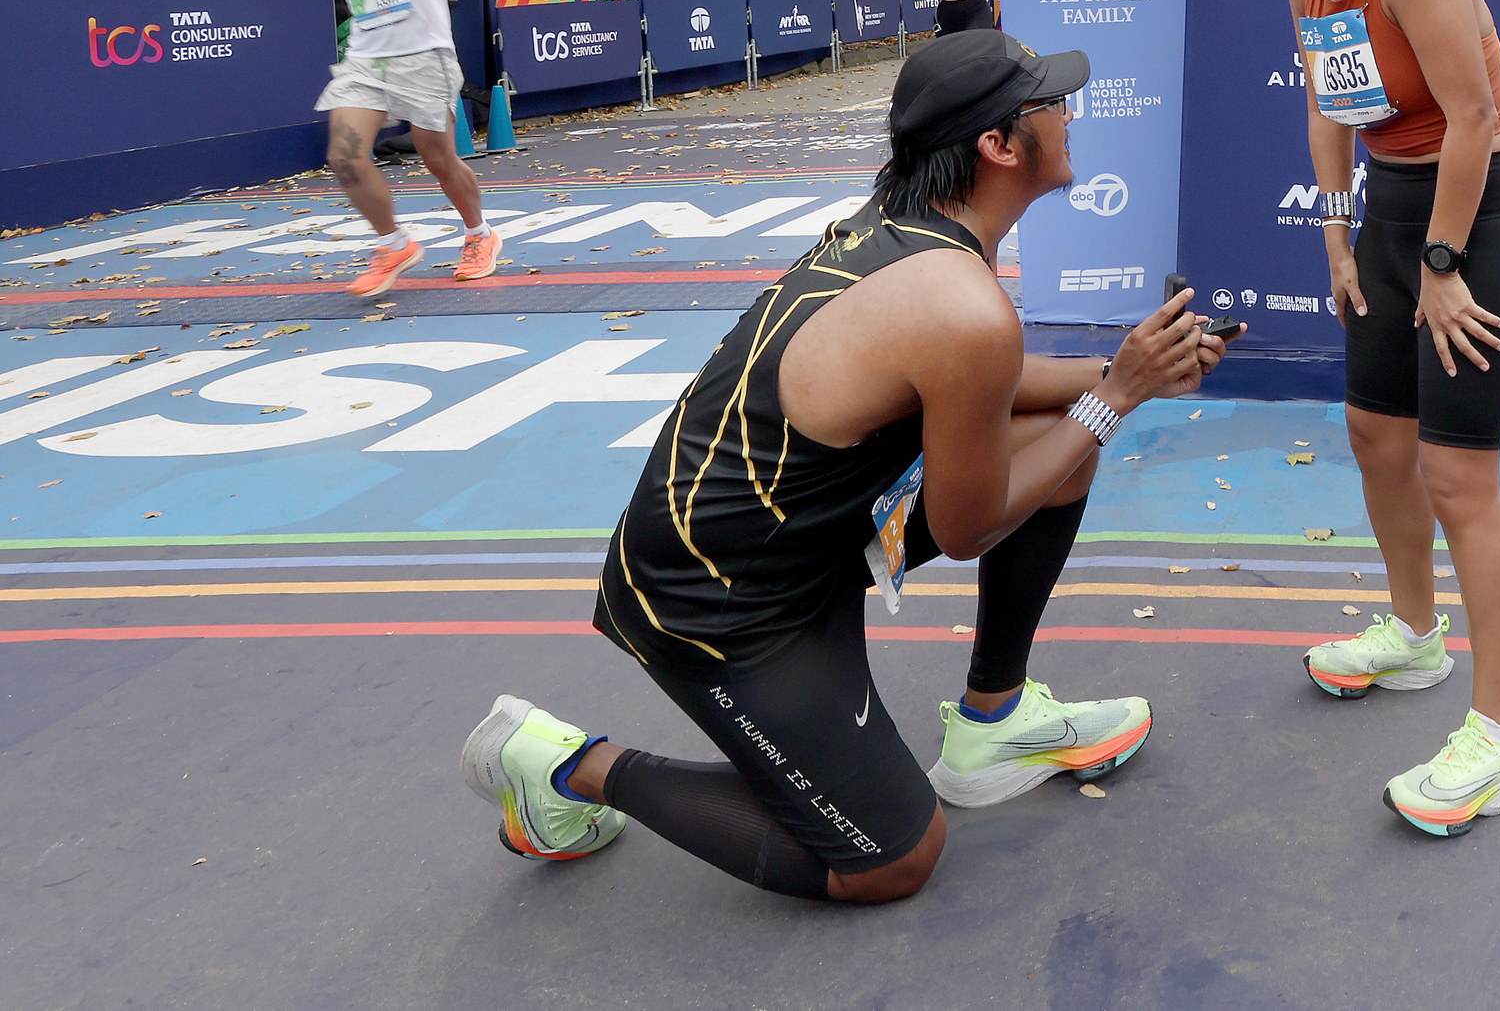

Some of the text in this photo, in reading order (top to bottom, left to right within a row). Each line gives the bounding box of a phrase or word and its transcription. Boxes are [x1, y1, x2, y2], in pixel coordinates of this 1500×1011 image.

[914, 0, 939, 9] UNITED
[170, 11, 212, 25] TATA
[1062, 7, 1135, 24] FAMILY
[171, 25, 263, 43] CONSULTANCY
[570, 22, 591, 32] TATA
[88, 17, 164, 67] tcs
[532, 26, 569, 62] tcs
[571, 31, 618, 45] CONSULTANCY
[689, 37, 715, 51] TATA
[1332, 33, 1353, 43] TATA
[172, 44, 232, 61] SERVICES
[572, 45, 603, 57] SERVICES
[1323, 50, 1369, 91] 19335
[1090, 78, 1137, 89] ABBOTT
[1090, 88, 1133, 98] WORLD
[1091, 96, 1161, 108] MARATHON
[1332, 98, 1354, 107] 2022
[1091, 107, 1141, 118] MAJORS
[1071, 178, 1123, 216] abc 7
[1277, 216, 1303, 225] NEW
[1306, 217, 1322, 227] YO
[1059, 266, 1144, 291] ESPN
[1266, 294, 1313, 306] CENTRAL PARK
[1266, 302, 1313, 313] CONSERVANCY
[889, 520, 899, 536] 2
[710, 686, 734, 709] NO
[734, 715, 787, 766] HUMAN
[786, 769, 812, 790] IS
